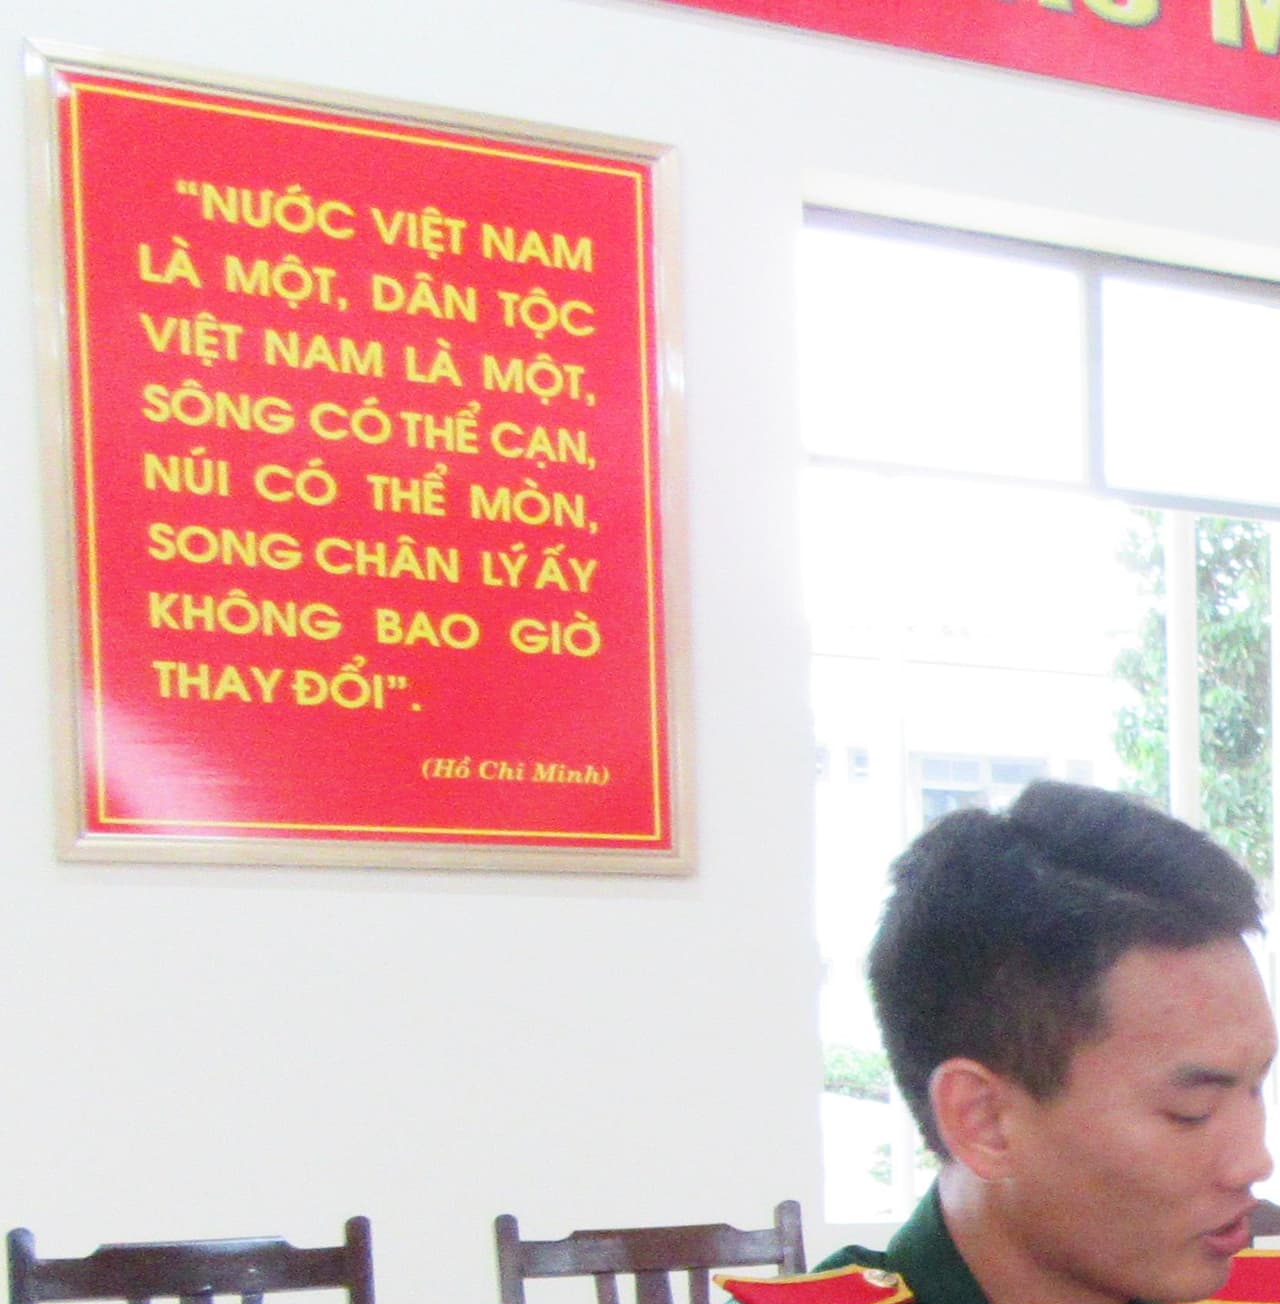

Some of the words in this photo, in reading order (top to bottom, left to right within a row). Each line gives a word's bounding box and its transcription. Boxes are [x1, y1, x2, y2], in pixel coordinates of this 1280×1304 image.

[370, 206, 467, 260] VIỆT
[481, 223, 594, 272] NAM
[138, 236, 202, 288] LÀ
[223, 254, 348, 311] MỘT,
[371, 272, 478, 322] DÂN
[498, 286, 596, 339] TỘC
[138, 312, 244, 367] VIỆT
[264, 328, 384, 377] NAM
[404, 338, 463, 387] LÀ
[482, 352, 597, 406] MỘT,
[142, 379, 296, 435] SÔNG
[309, 396, 393, 445] CÓ
[399, 400, 481, 454] THỂ
[490, 422, 597, 470] CẠN,
[143, 446, 230, 496] NÚI
[254, 457, 338, 506] CÓ
[366, 462, 449, 516] THỂ
[469, 478, 598, 535] MÒN,
[148, 522, 302, 570] SONG
[314, 535, 460, 583] CHÂN
[481, 542, 529, 588] LÝ
[534, 543, 598, 593] ẤY
[148, 588, 342, 641] KHÔNG
[375, 608, 481, 649] BAO
[508, 610, 602, 657] GIỜ
[152, 660, 284, 703] THAY
[531, 762, 611, 786] Minh)
